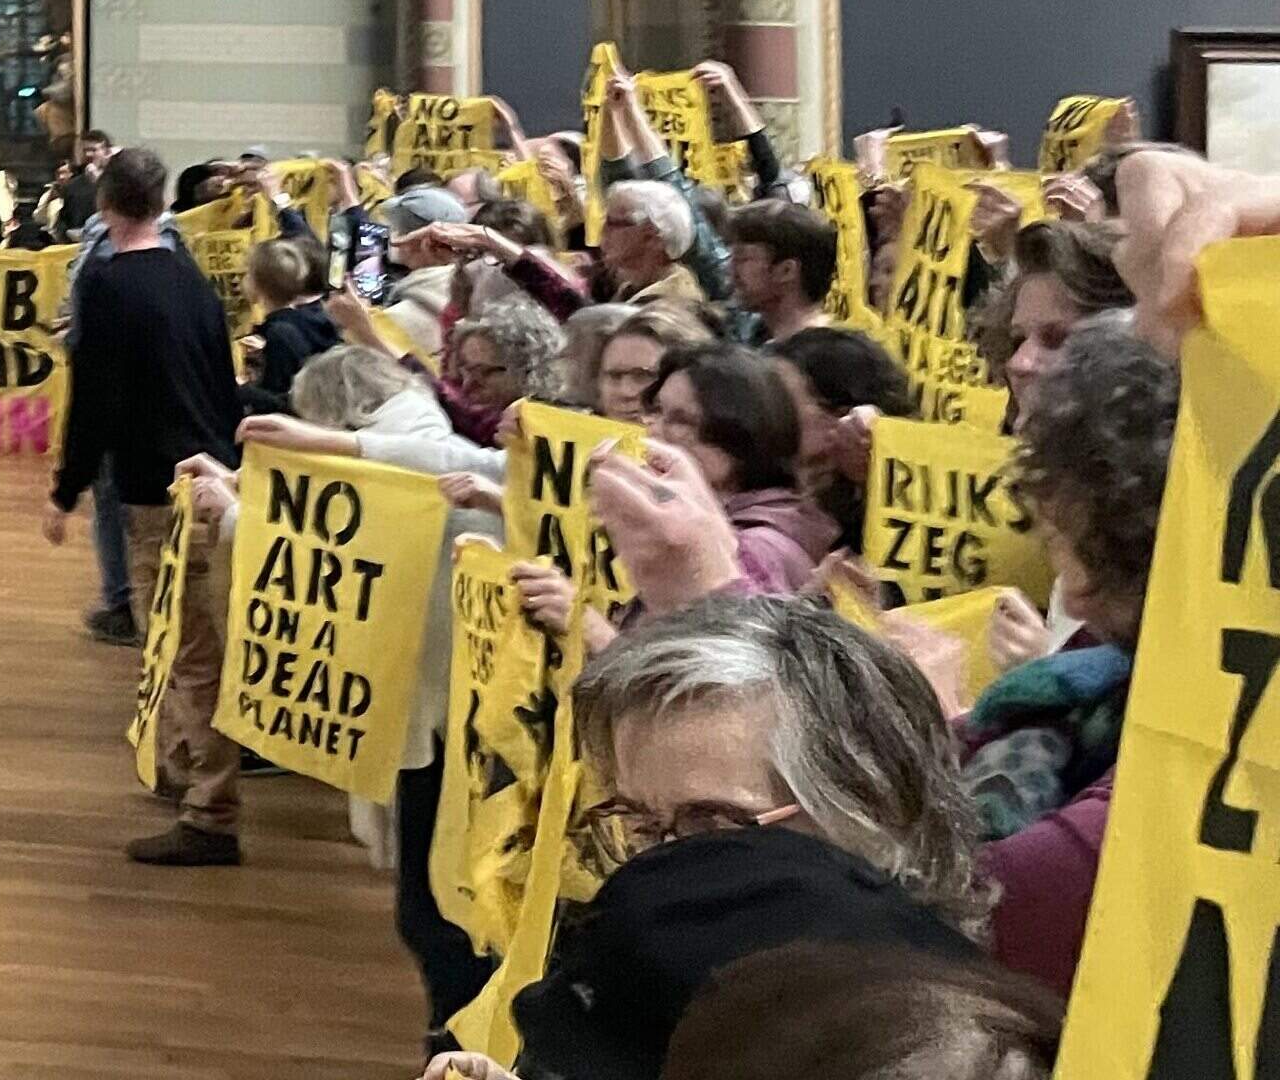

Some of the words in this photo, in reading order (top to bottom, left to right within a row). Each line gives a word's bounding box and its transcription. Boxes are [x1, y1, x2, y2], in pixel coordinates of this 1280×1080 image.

[412, 123, 474, 151] ART
[414, 99, 459, 121] NO
[267, 466, 362, 547] NO
[531, 435, 593, 507] N
[253, 535, 385, 622] ART
[536, 513, 619, 593] AR
[881, 517, 988, 586] ZEG
[246, 598, 300, 645] ON
[310, 620, 335, 656] A
[242, 639, 372, 718] DEAD
[238, 691, 367, 762] PLANET
